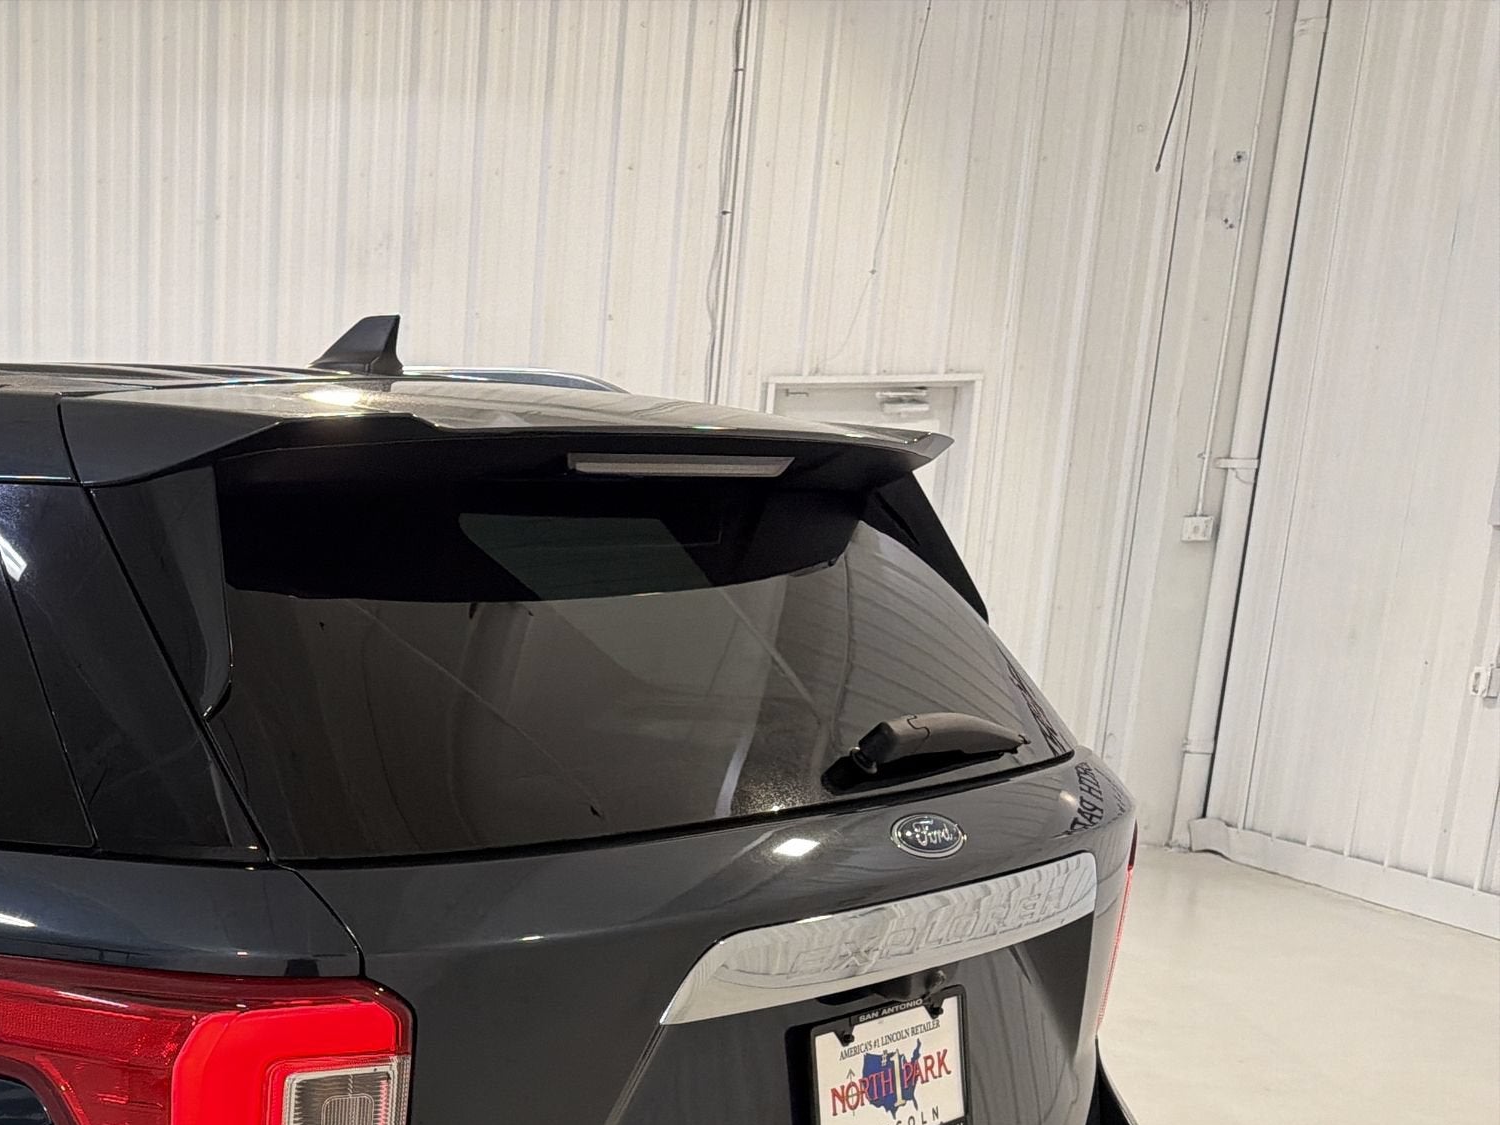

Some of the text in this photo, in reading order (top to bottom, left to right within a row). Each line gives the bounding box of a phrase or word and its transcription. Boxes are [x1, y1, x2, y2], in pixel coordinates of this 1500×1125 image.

[911, 818, 953, 847] Ford
[859, 998, 923, 1023] SAN ANTONIO
[839, 1040, 873, 1061] AMERICA'S
[881, 1029, 910, 1047] LINCOLN
[910, 1019, 941, 1037] RETAILER
[831, 1049, 952, 1116] NORTH PARK
